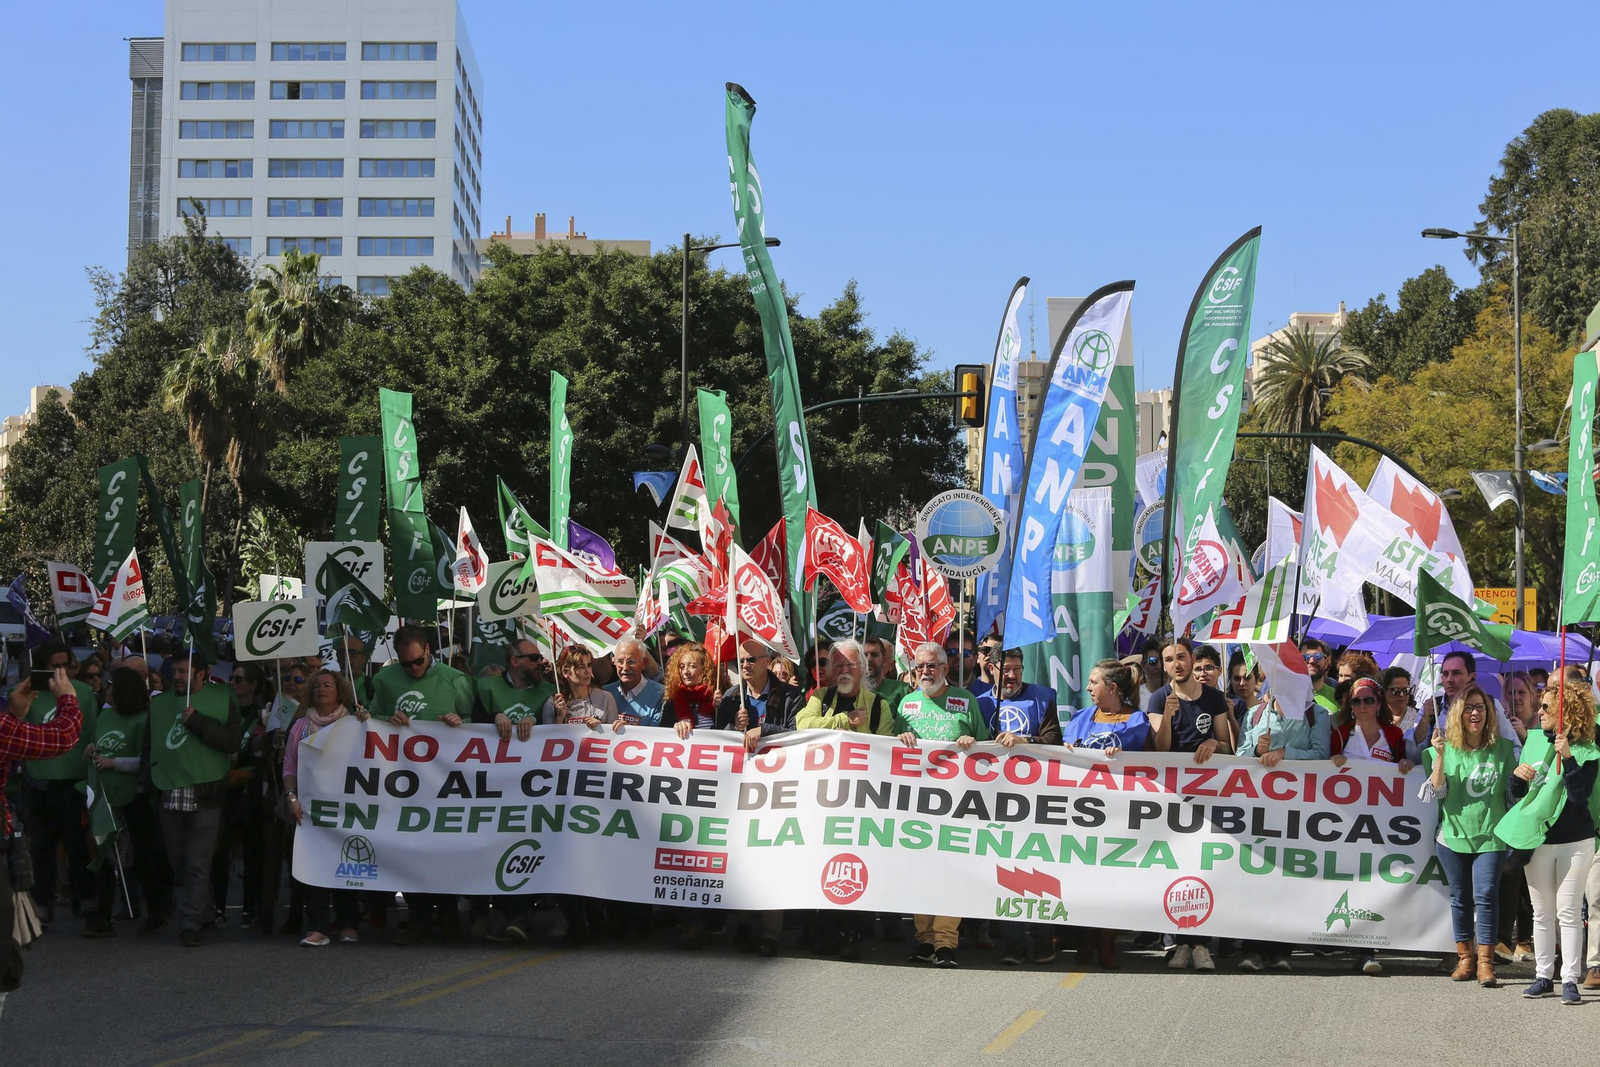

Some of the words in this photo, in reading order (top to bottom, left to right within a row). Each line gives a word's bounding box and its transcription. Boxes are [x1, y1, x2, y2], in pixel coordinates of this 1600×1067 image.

[921, 494, 952, 522] SINDICATO
[953, 492, 1003, 527] INDEPENDIENTE
[1021, 402, 1085, 630] ANPE
[1137, 506, 1155, 535] SINDICATO
[933, 537, 988, 555] ANPE
[1053, 546, 1085, 560] NPE
[937, 565, 987, 578] ANDALUCÍA
[1375, 561, 1418, 597] MÁLA
[1474, 588, 1516, 598] ATENCIÓ
[1427, 612, 1483, 648] CSIF
[399, 700, 428, 713] CSIF
[364, 731, 439, 763] NO
[454, 738, 522, 764] AL
[541, 737, 787, 774] DECRETO
[803, 742, 871, 772] DE
[890, 746, 1405, 808] ESCOLARIZACIÓN
[344, 766, 420, 798] NO
[436, 770, 502, 799] AL
[520, 768, 718, 809] CIERRE
[737, 780, 799, 811] DE
[816, 778, 1106, 828] UNIDADES
[1128, 795, 1422, 846] PÚBLICAS
[310, 799, 379, 831] EN
[397, 804, 640, 840] DEFENSA
[659, 813, 729, 846] DE
[747, 817, 805, 847] LA
[822, 816, 1179, 870] ENSEÑANZA
[1200, 838, 1450, 886] PÚBLICA
[505, 855, 545, 874] CSIF
[659, 853, 708, 868] CCOO
[335, 863, 377, 877] ANPE
[828, 861, 863, 882] UGT
[653, 874, 724, 889] enseñanza
[654, 887, 722, 905] Málaga
[1169, 888, 1205, 902] FRENTE
[995, 897, 1068, 921] USTEA
[1170, 903, 1209, 914] ESTUDIANTES
